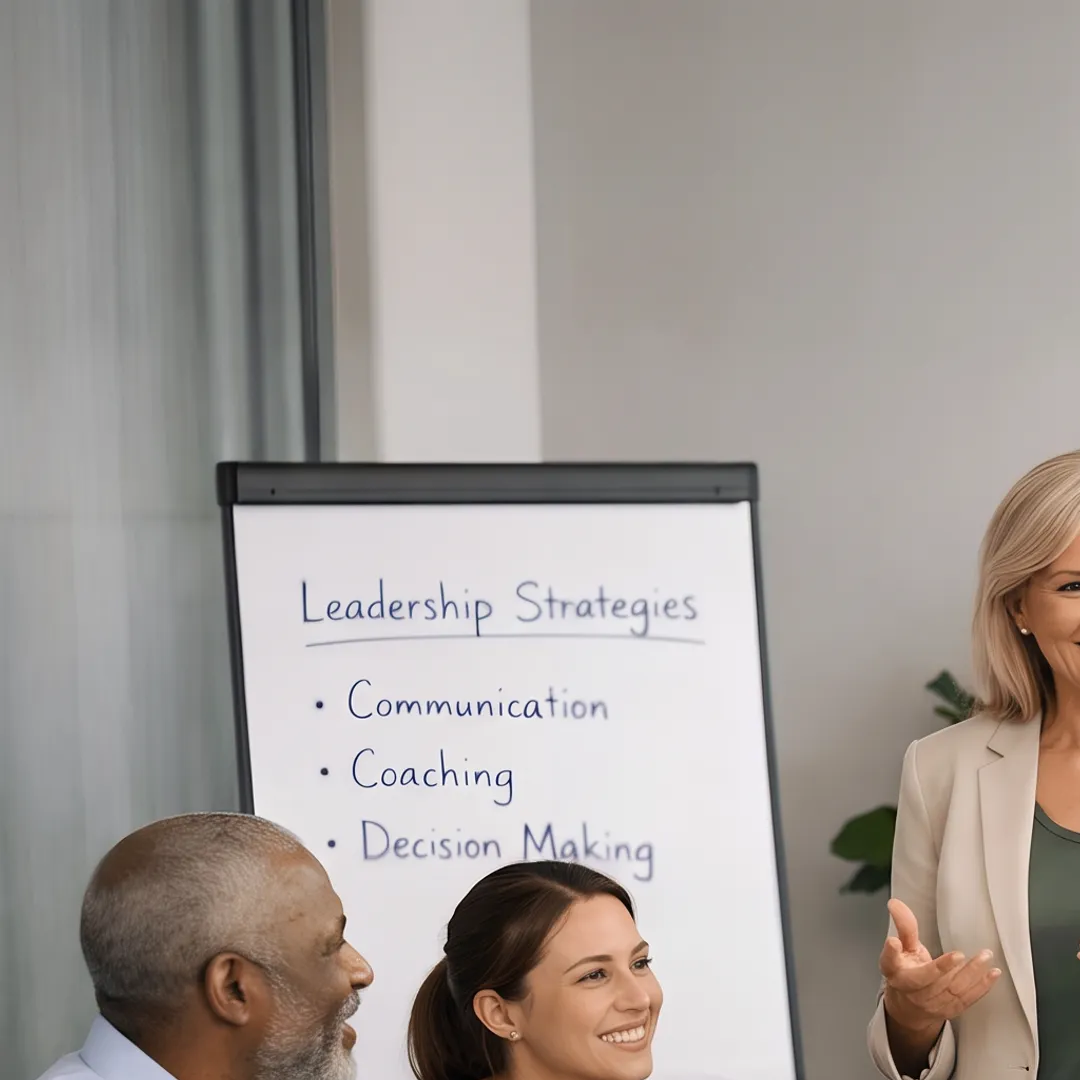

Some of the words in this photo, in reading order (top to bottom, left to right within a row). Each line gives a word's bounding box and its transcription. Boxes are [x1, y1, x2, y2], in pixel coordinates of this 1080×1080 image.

[301, 578, 493, 637] Leadership
[515, 581, 699, 637] Strategies
[347, 679, 609, 720] Communication
[352, 748, 514, 807] Coaching
[361, 820, 502, 861] Decision
[522, 822, 655, 883] Making
